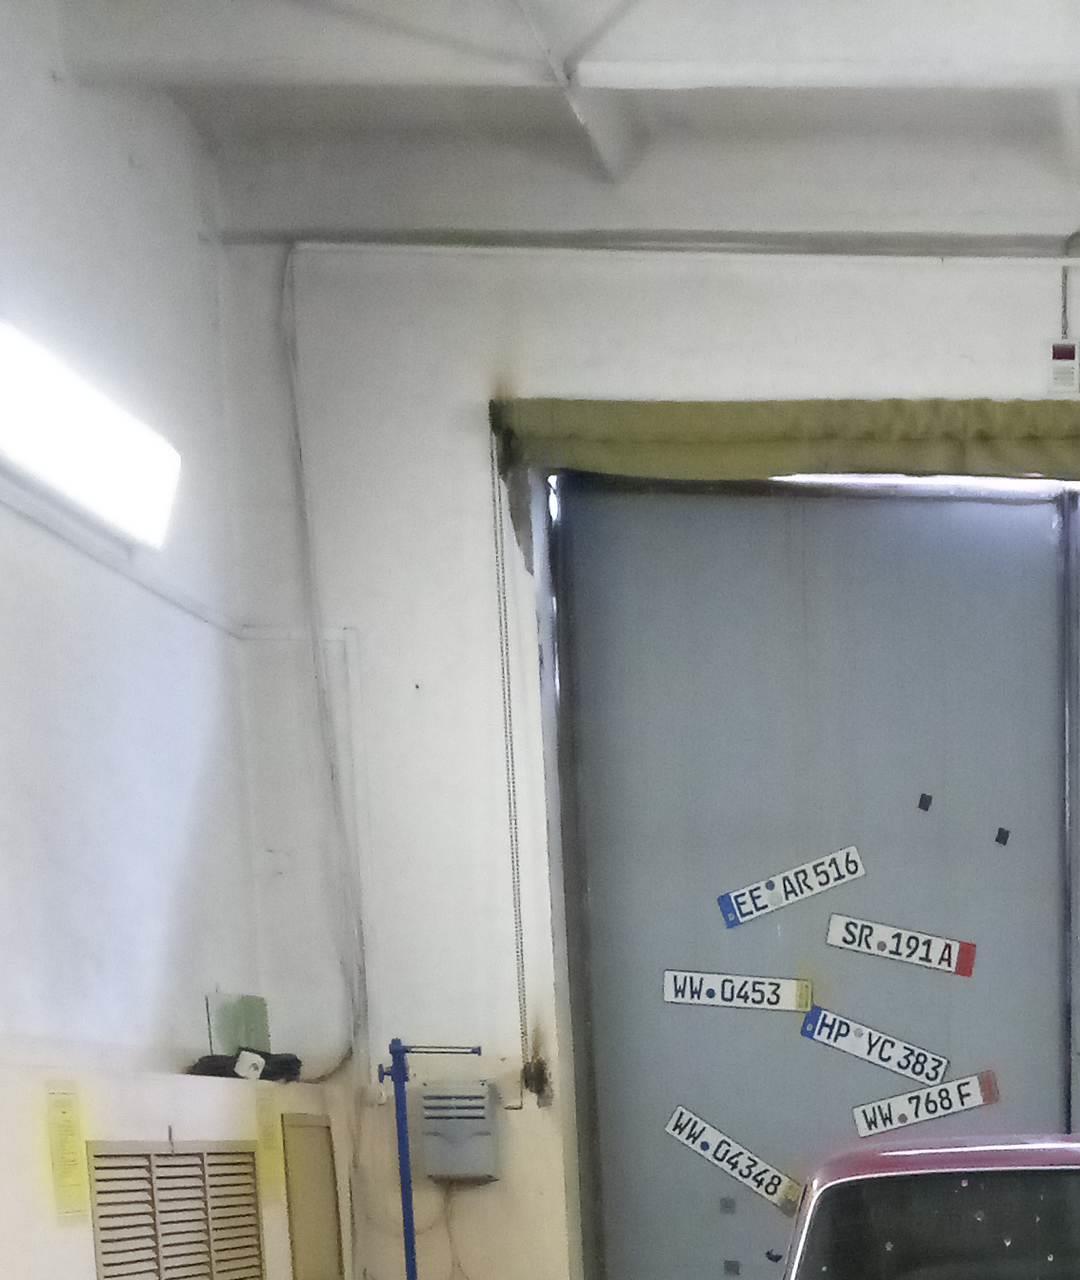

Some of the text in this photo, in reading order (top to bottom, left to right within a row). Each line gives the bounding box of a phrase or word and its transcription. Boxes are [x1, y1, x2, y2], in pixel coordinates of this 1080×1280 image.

[733, 886, 768, 918] EE
[842, 921, 873, 949] SR
[673, 975, 781, 1006] WW 0453
[817, 1013, 850, 1043] HP
[862, 1102, 893, 1131] WW
[672, 1111, 782, 1196] WW 04348
